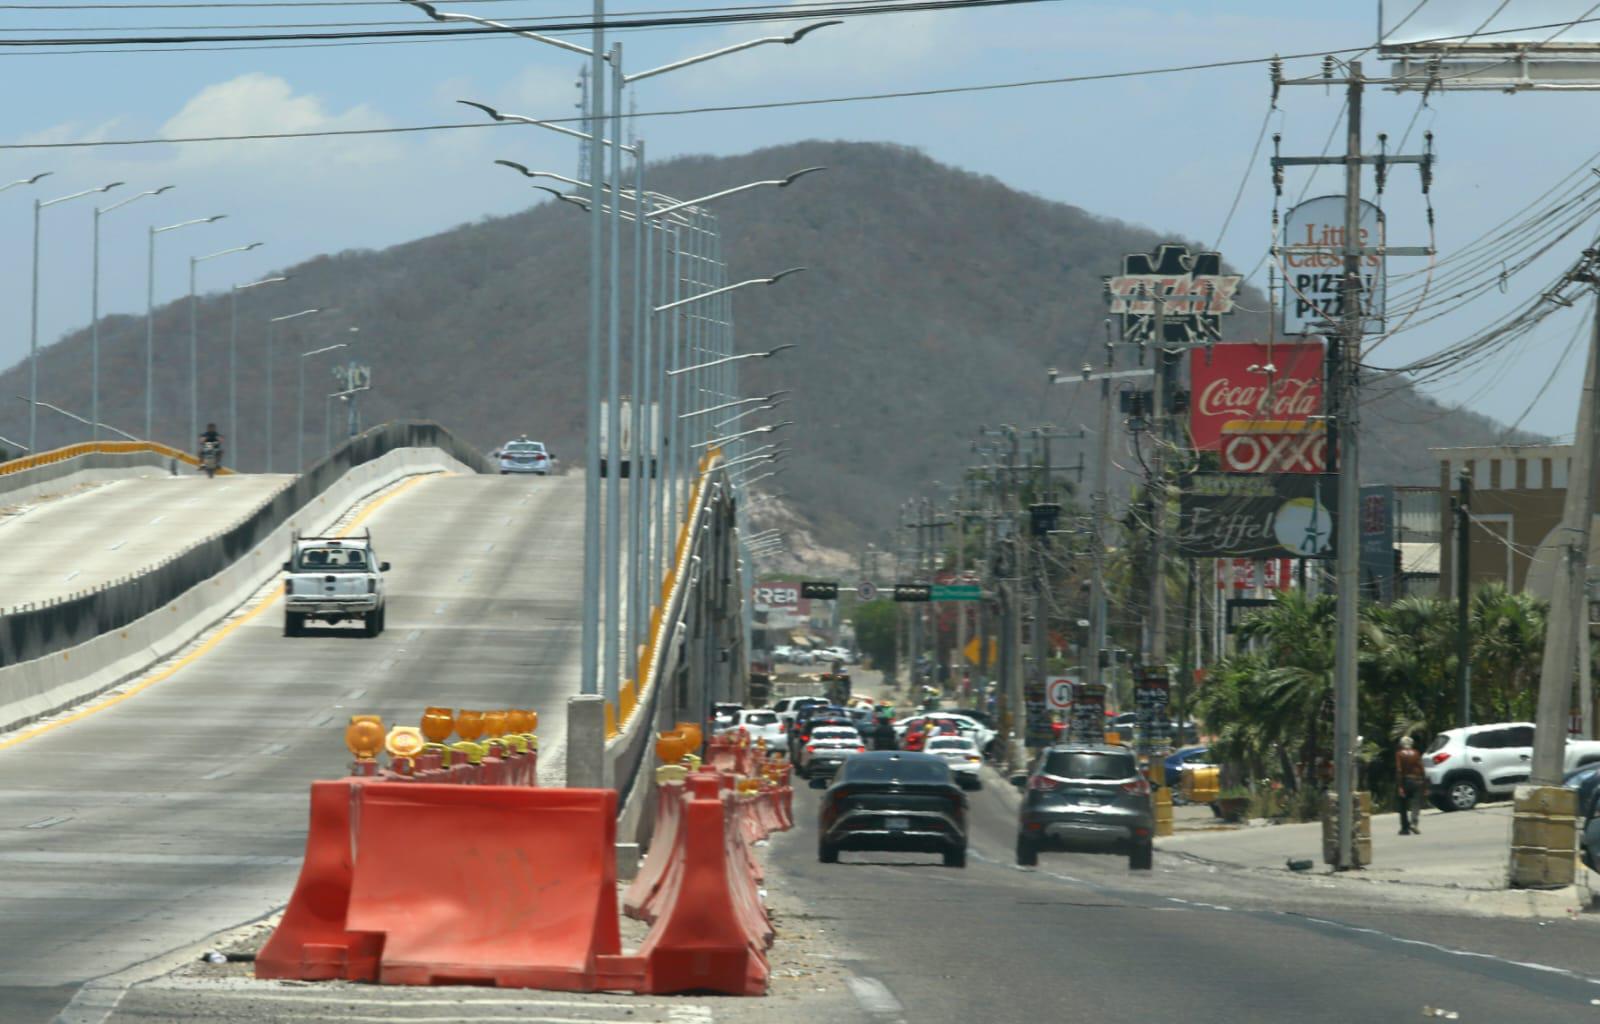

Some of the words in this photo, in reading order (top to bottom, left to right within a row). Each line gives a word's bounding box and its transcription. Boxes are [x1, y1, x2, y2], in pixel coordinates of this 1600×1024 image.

[1305, 224, 1368, 247] Litte
[1296, 298, 1371, 318] PIZZ!
[1184, 506, 1275, 549] Eiffel
